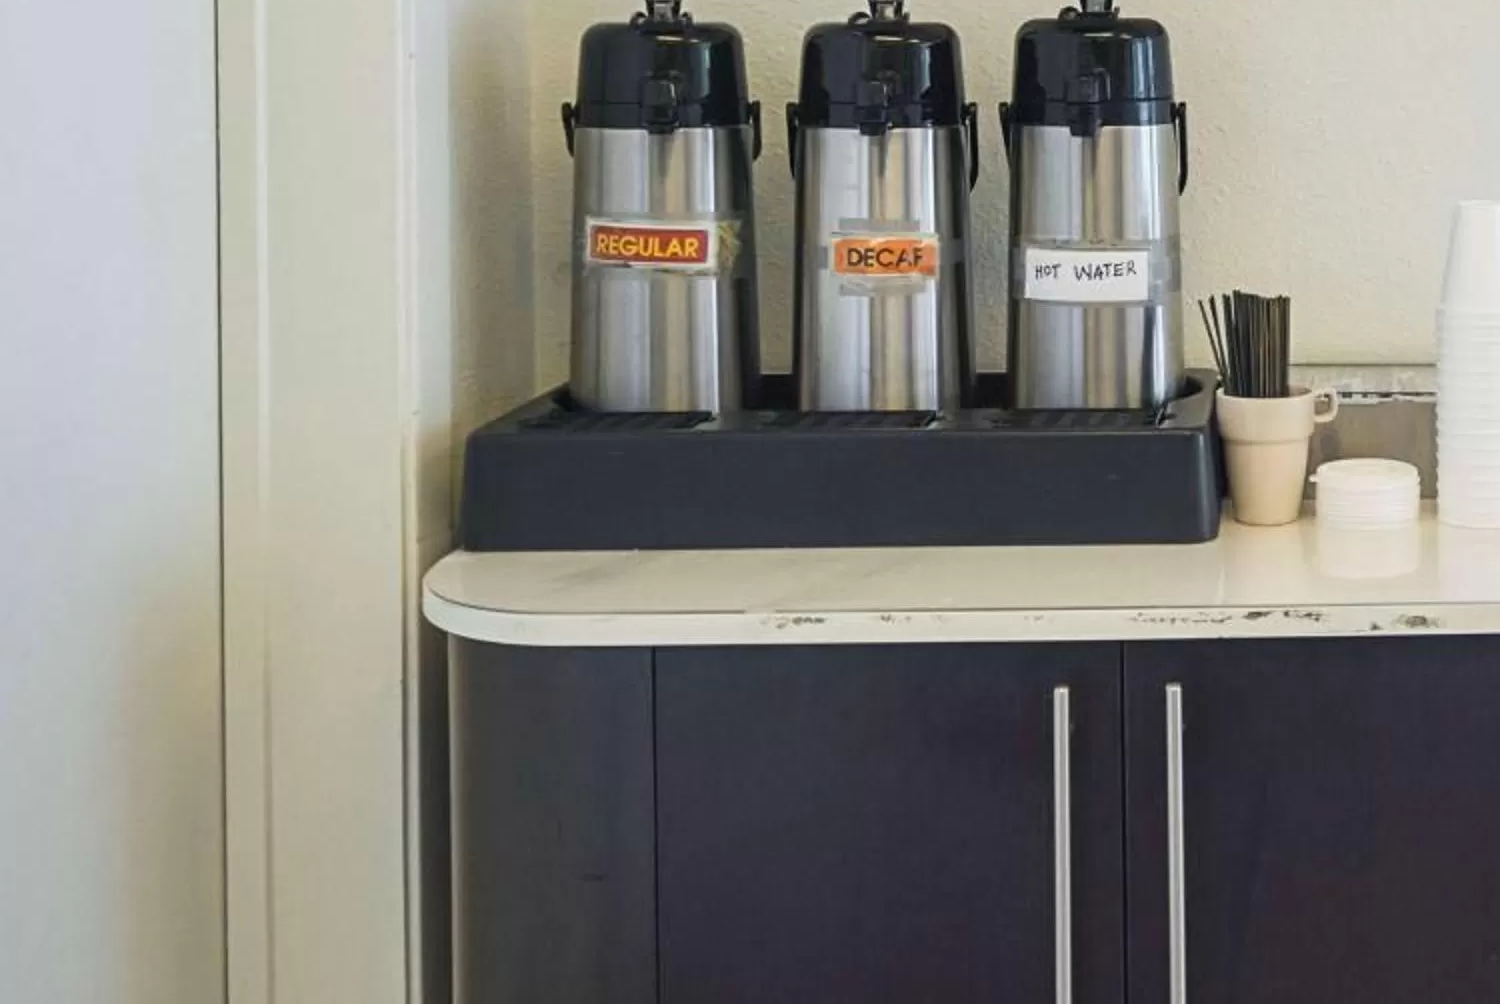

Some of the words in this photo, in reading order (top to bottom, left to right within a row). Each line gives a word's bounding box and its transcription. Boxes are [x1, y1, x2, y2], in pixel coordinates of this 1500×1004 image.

[595, 232, 700, 259] REGULAR
[847, 246, 925, 269] DECAF
[1035, 262, 1061, 280] HOT
[1074, 259, 1137, 281] WATER
